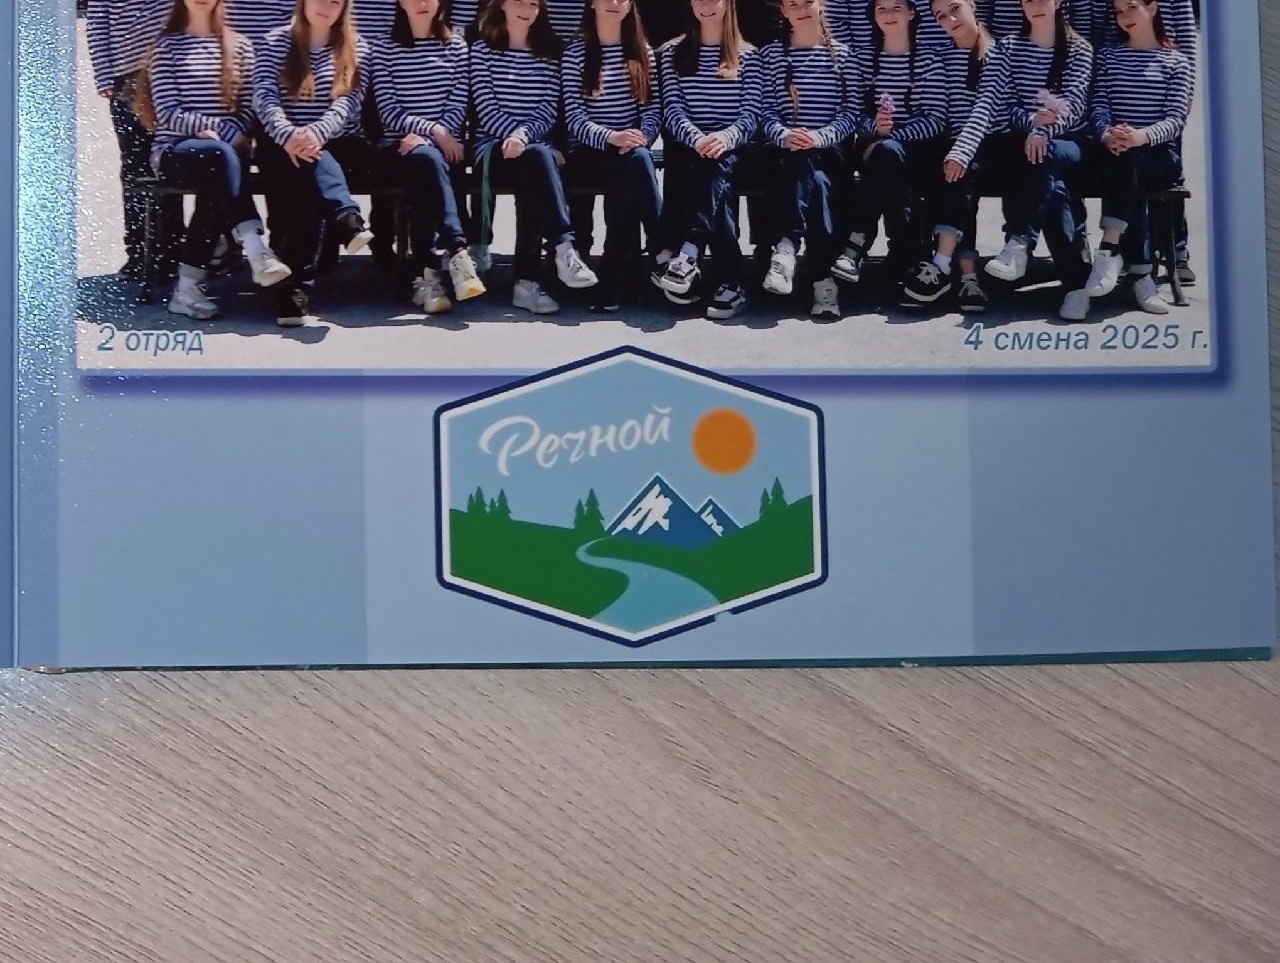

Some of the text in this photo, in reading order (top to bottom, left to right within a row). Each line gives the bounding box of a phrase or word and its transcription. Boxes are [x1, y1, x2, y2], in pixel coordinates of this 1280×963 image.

[97, 323, 204, 356] 2 отряд
[964, 323, 1209, 351] 4 смена 2025 г.
[478, 403, 673, 476] Речной
